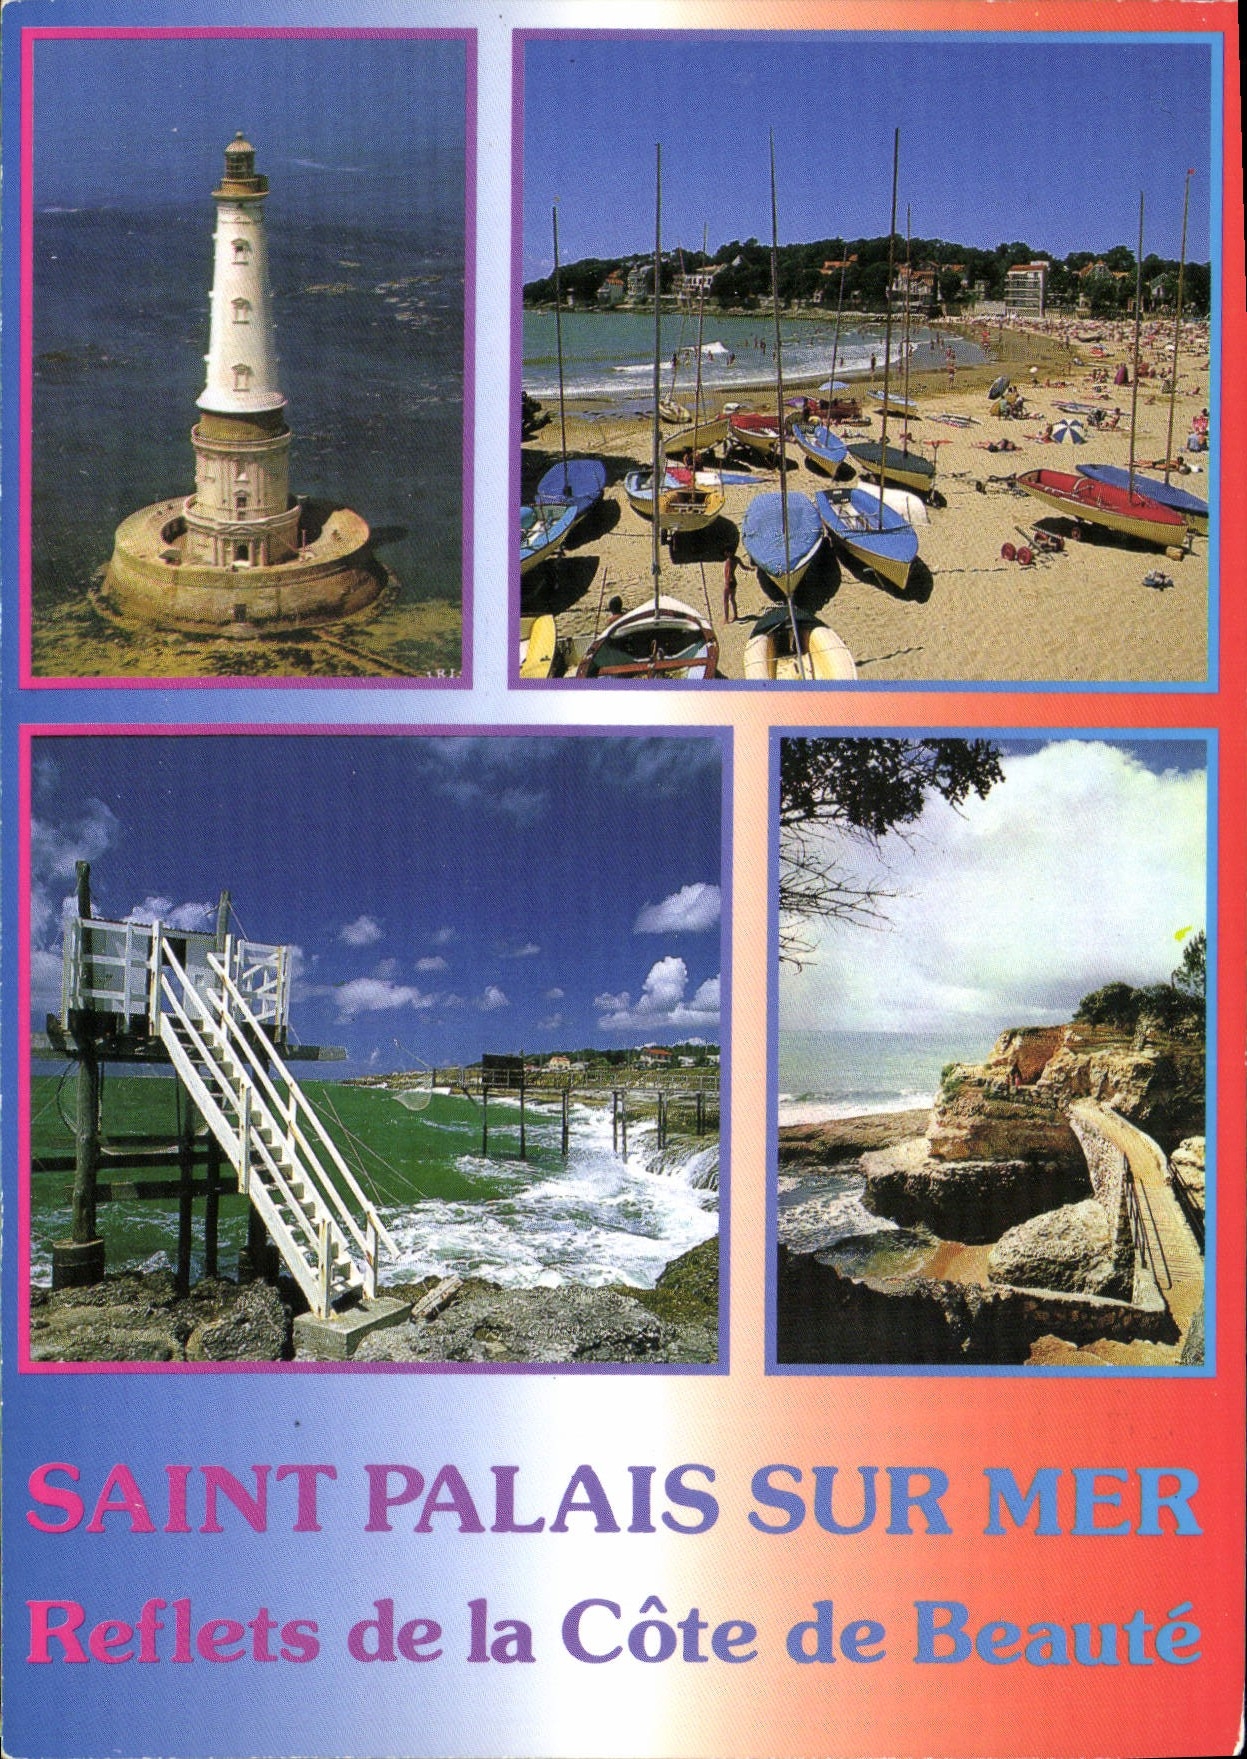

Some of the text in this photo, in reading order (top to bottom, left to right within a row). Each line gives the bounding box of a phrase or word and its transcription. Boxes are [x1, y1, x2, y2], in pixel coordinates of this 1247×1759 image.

[26, 1462, 1204, 1536] SAINT PALAIS SUR MER
[25, 1595, 1202, 1666] Reflets de la Côte de Beauté
